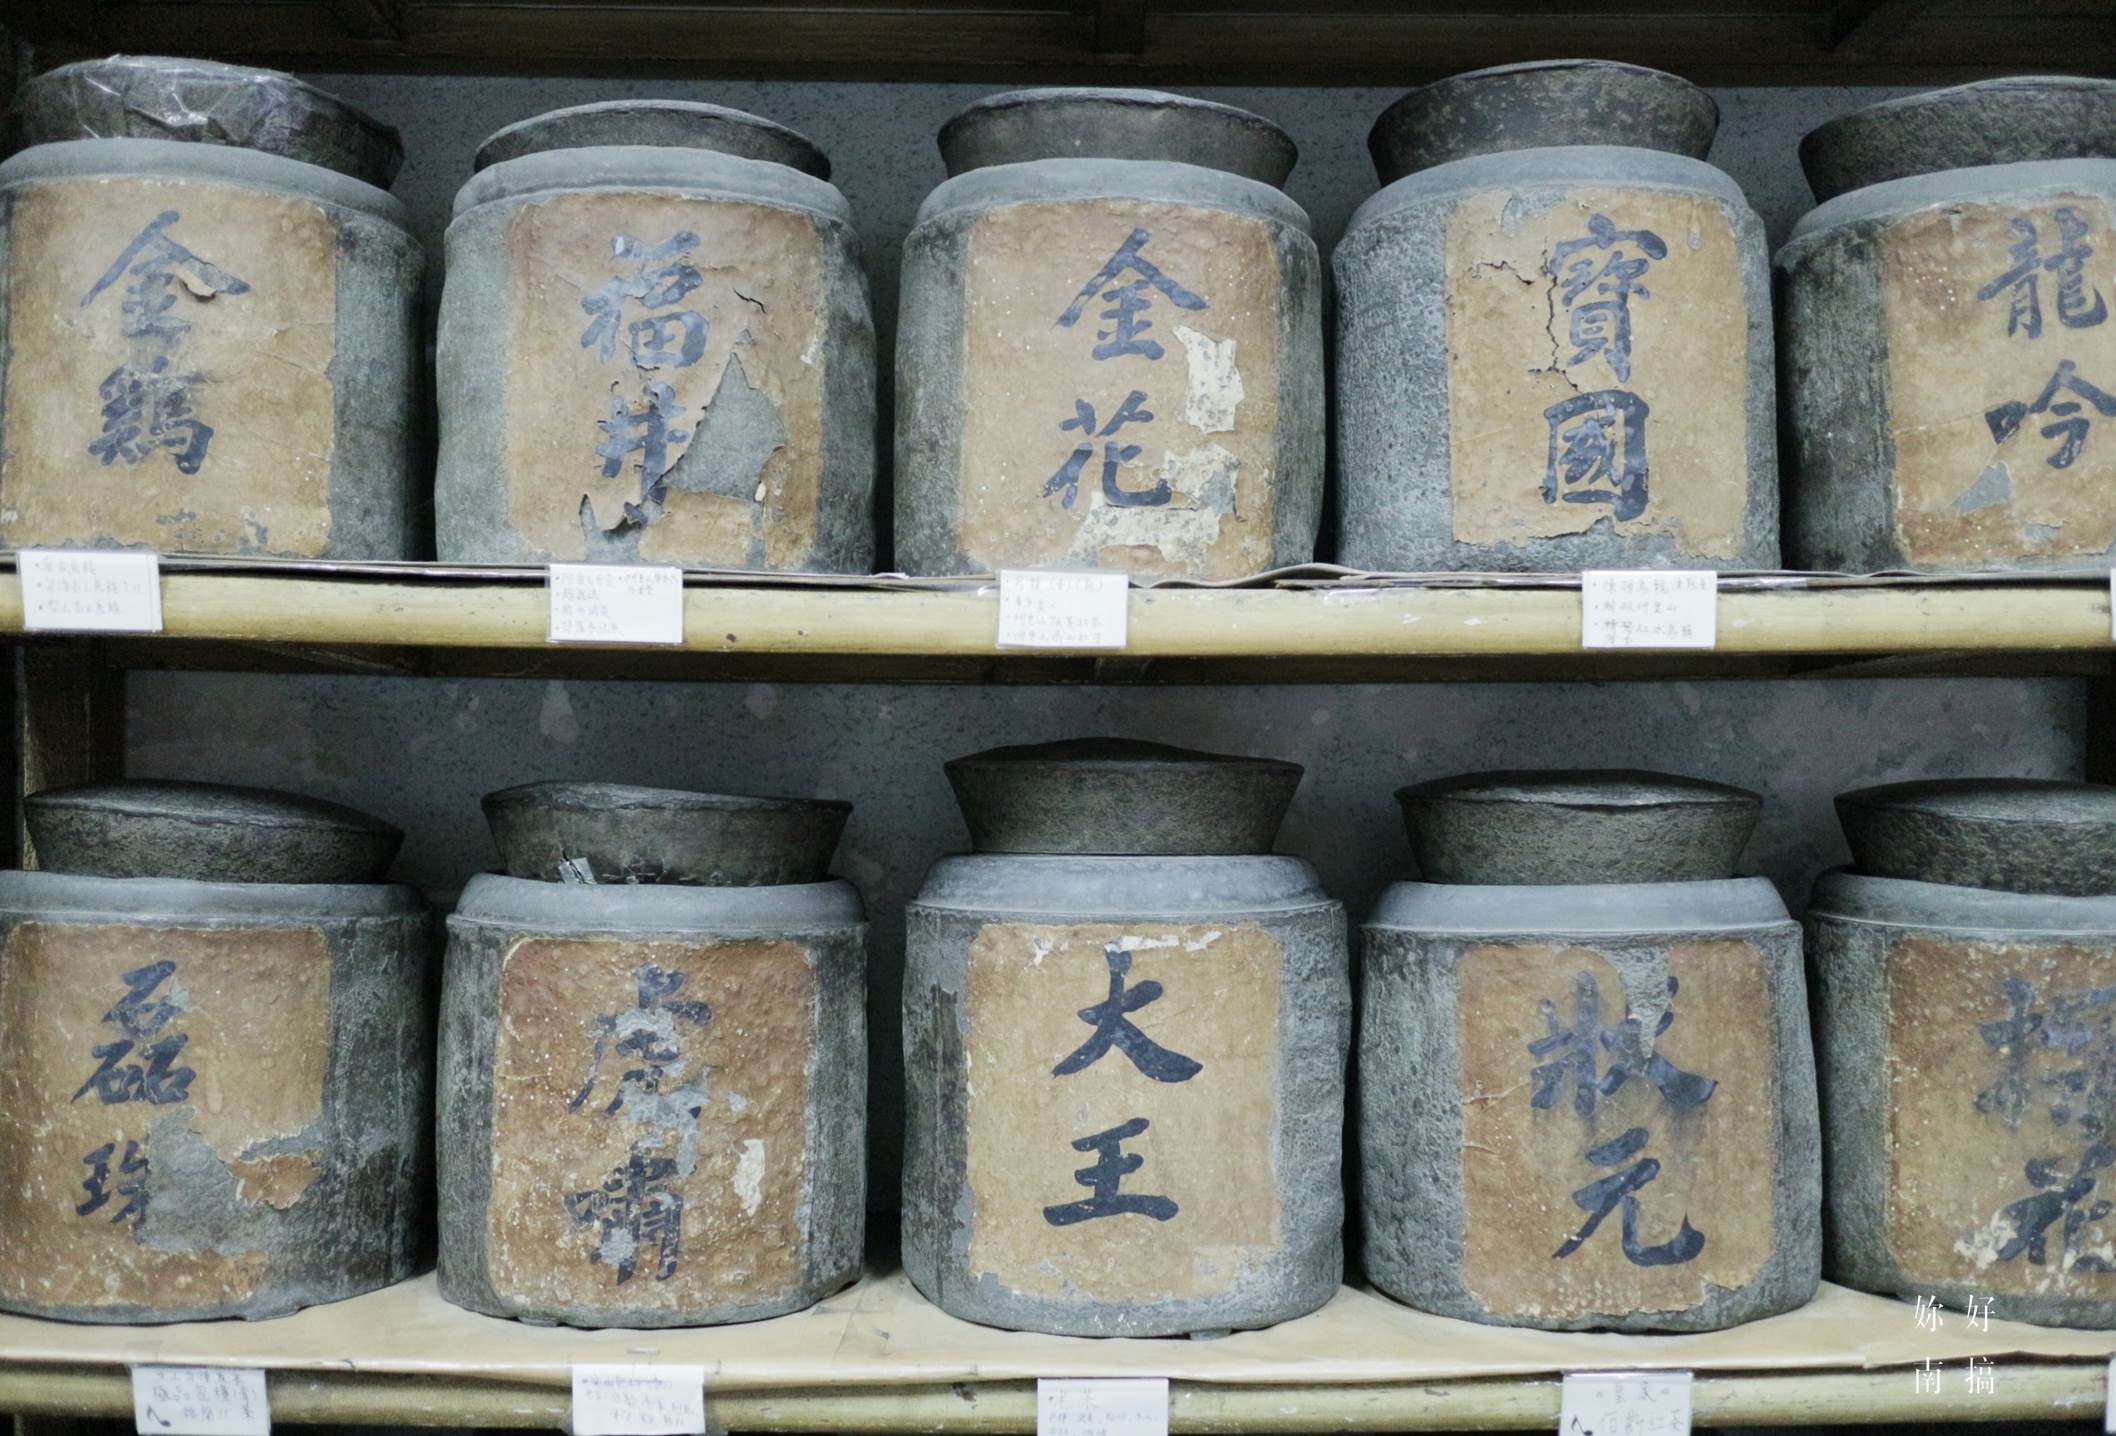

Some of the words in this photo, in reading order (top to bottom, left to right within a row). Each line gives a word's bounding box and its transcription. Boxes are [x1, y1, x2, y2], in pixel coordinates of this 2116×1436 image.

[1043, 228, 1211, 510] 金花
[1976, 207, 2116, 470] 龍吟
[1043, 951, 1203, 1227] 大王
